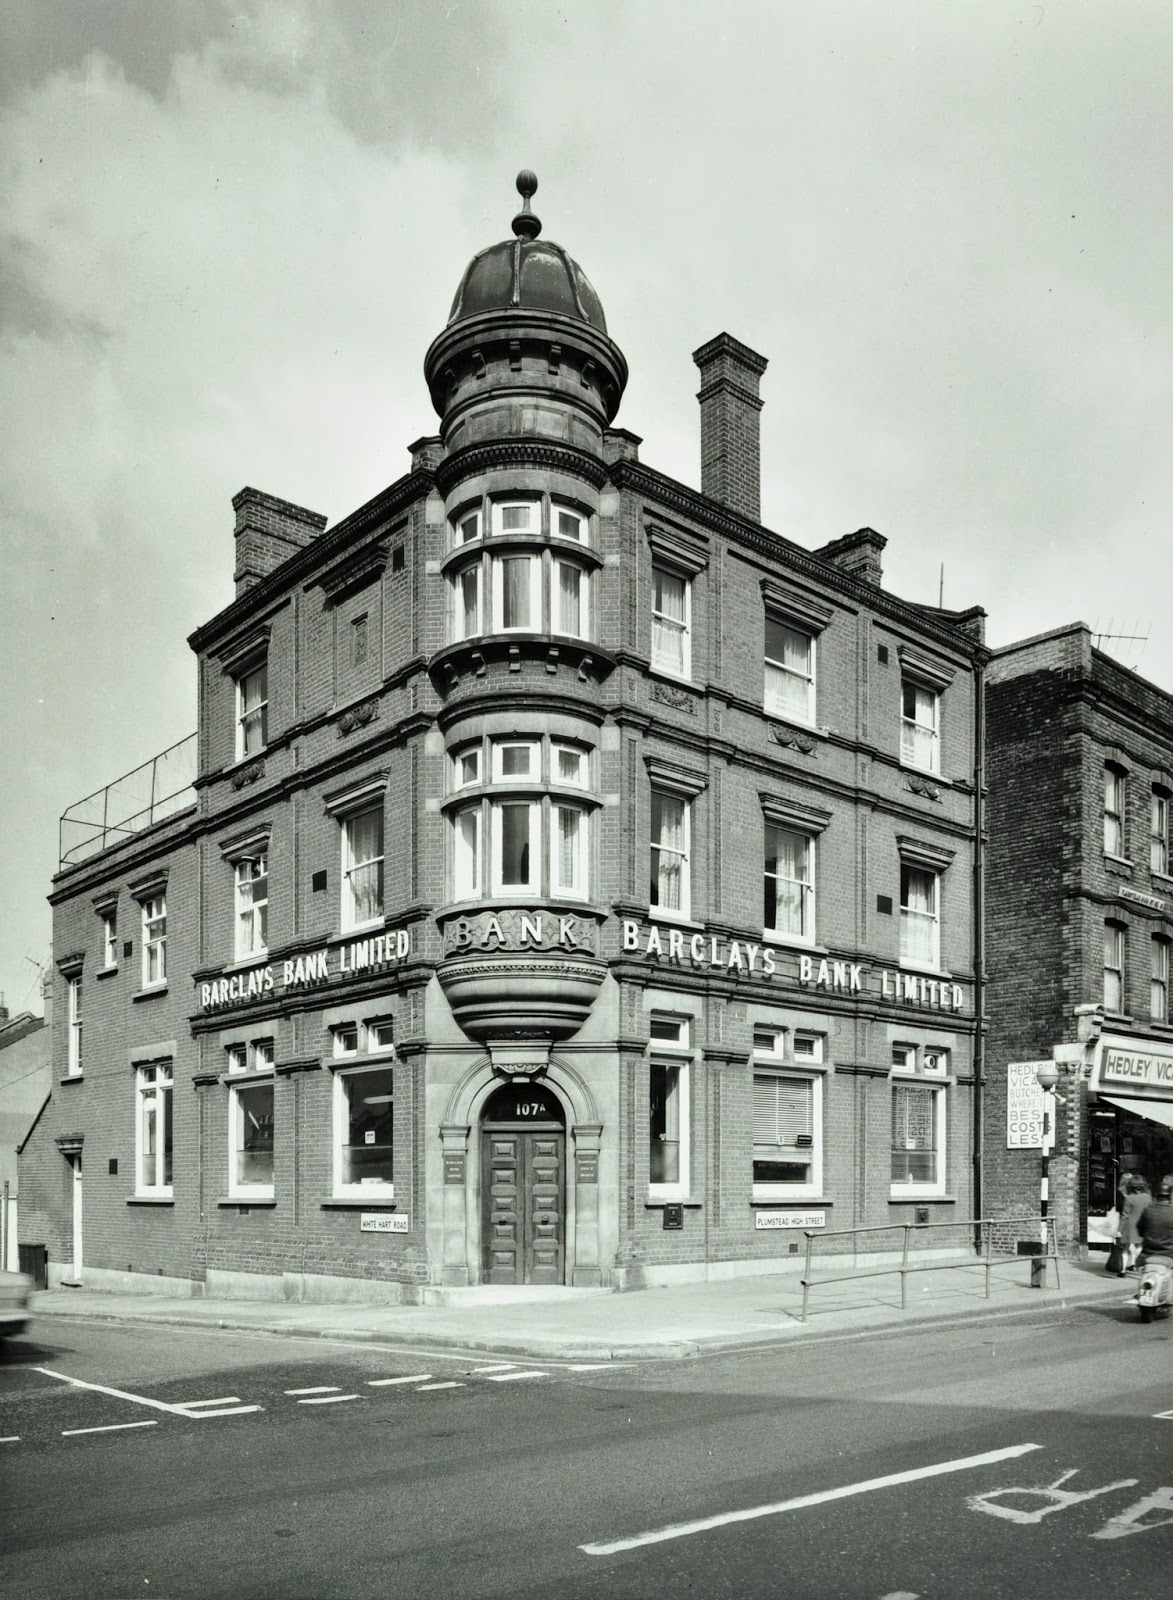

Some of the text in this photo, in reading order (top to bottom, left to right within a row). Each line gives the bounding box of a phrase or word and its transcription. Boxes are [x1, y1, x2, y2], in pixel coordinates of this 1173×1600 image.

[456, 917, 578, 947] BANK
[202, 930, 409, 1007] BARCLAYS BANK LIMITED
[623, 920, 963, 1008] BARCLAYS BANK LIMITED
[1010, 1064, 1052, 1076] HEDL
[1106, 1055, 1173, 1081] HEDLEY VIC
[1010, 1076, 1039, 1087] VICA
[1010, 1087, 1045, 1098] BUTCHE
[516, 1103, 546, 1115] 107A
[1010, 1110, 1046, 1121] BES
[362, 1220, 407, 1230] WHITE HART ROAD
[757, 1216, 824, 1226] PLUMSTEAD HIGH STREET
